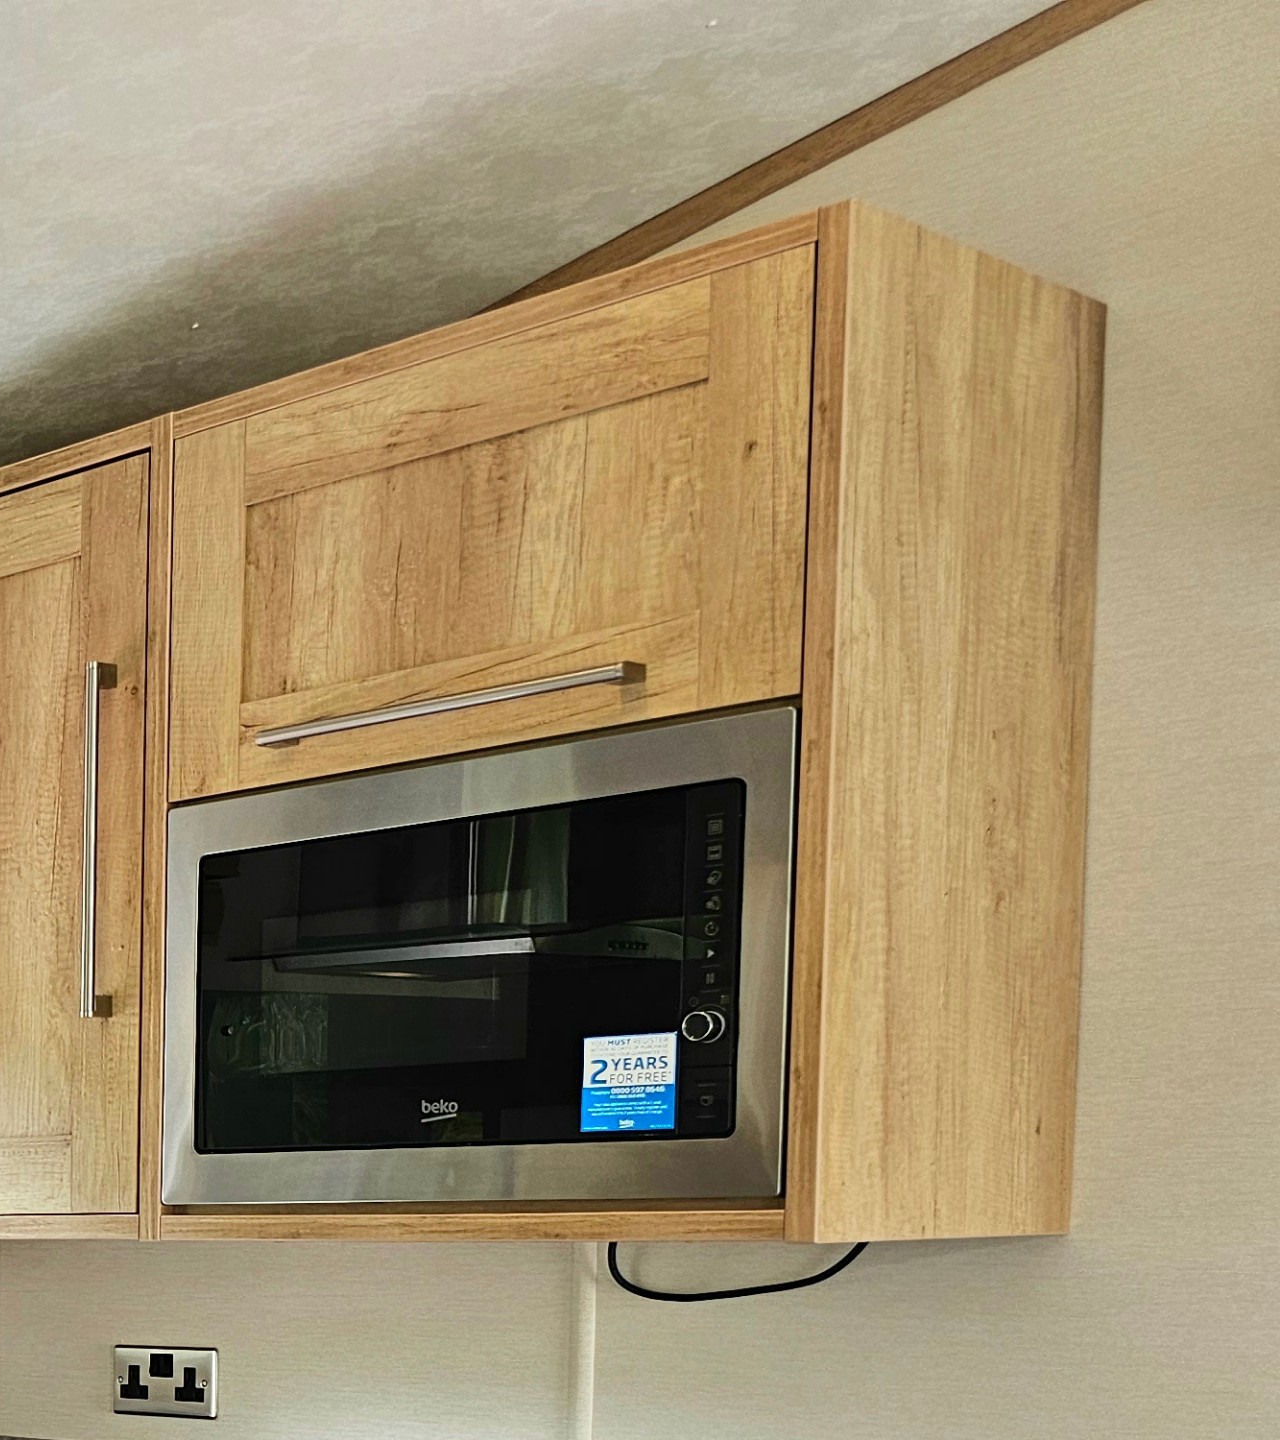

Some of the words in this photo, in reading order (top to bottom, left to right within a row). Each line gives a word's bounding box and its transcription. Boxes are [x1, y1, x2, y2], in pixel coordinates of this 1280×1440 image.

[608, 1038, 631, 1046] MUST
[590, 1059, 608, 1084] 2
[611, 1055, 668, 1071] YEARS
[609, 1073, 633, 1084] FOR
[421, 1099, 458, 1114] beko
